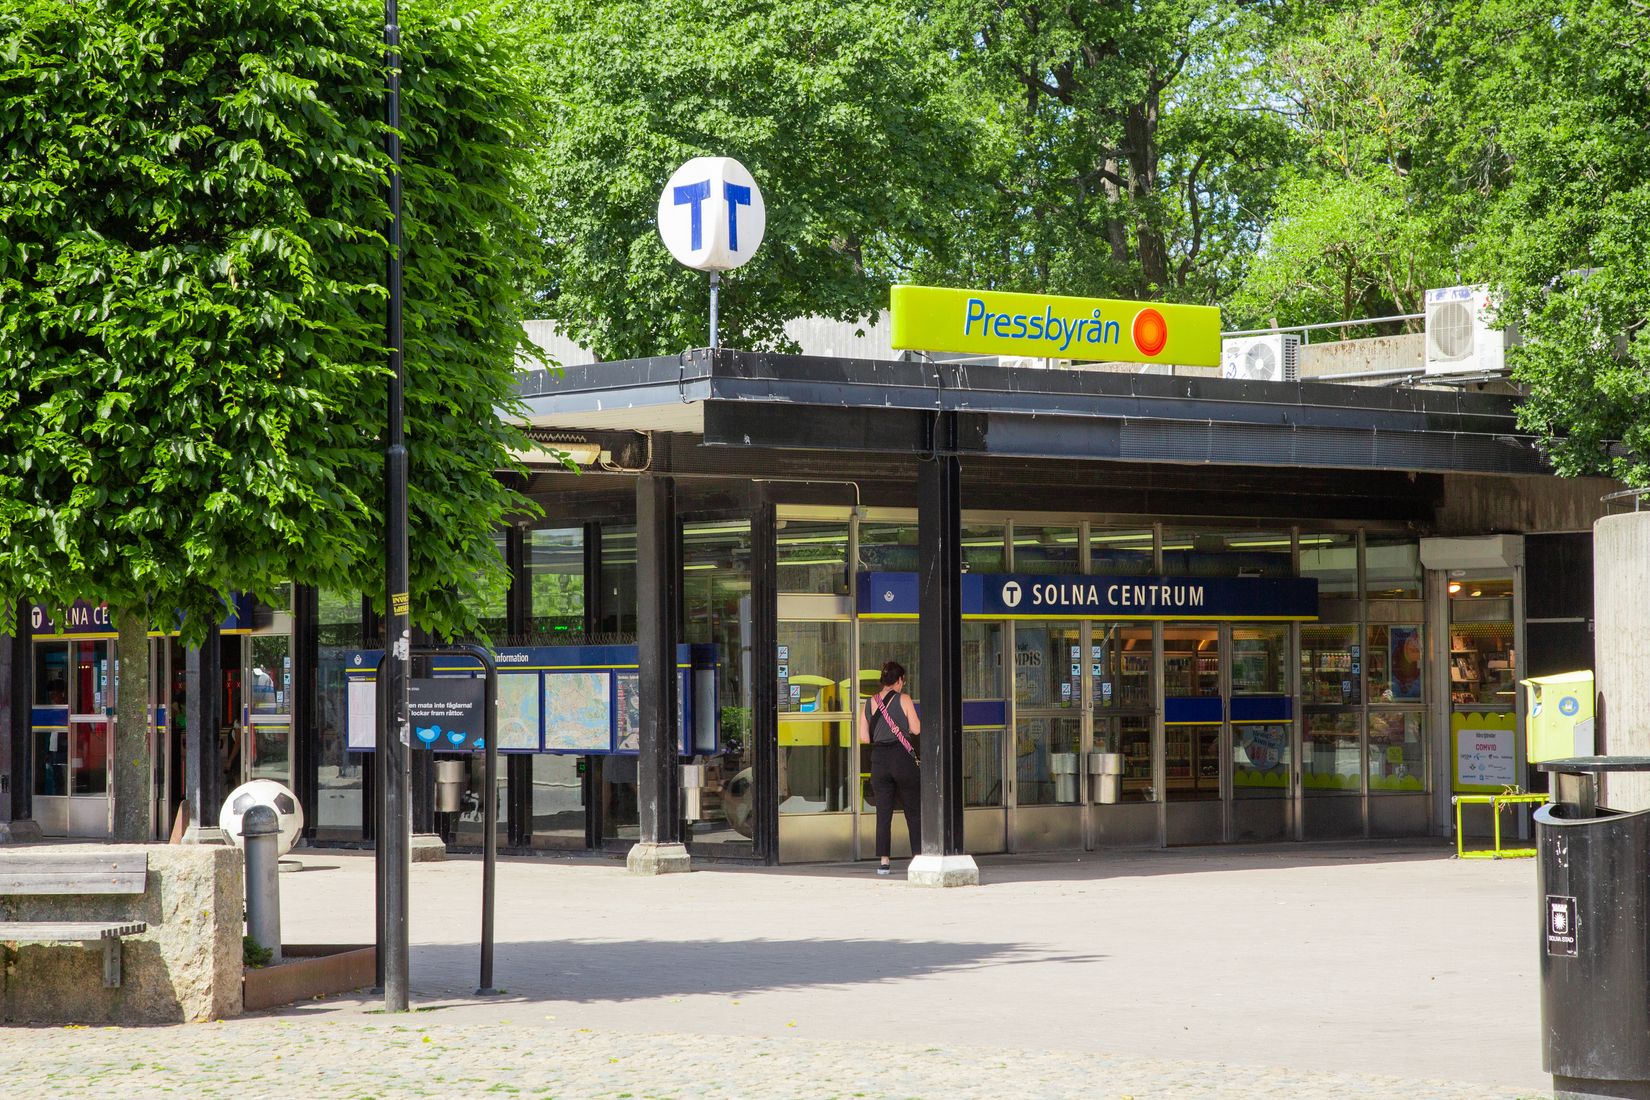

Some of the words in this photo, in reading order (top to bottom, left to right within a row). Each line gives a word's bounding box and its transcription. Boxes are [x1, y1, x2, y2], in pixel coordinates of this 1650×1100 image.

[673, 178, 711, 252] T
[722, 179, 751, 253] T
[964, 298, 1120, 351] Pressbyrån
[48, 606, 89, 626] LNA
[1032, 584, 1099, 606] SOLNA
[1107, 584, 1204, 606] CENTRUM
